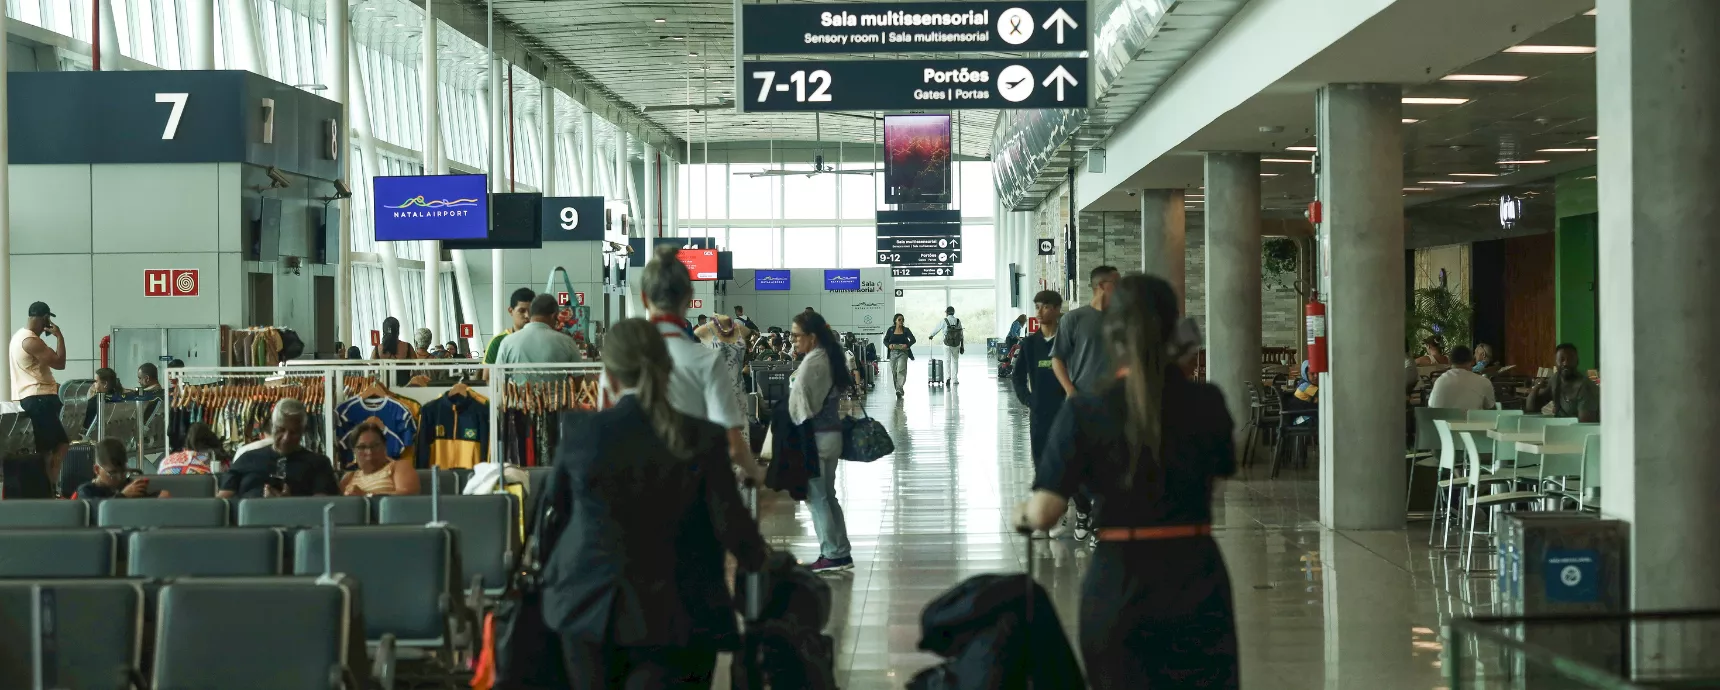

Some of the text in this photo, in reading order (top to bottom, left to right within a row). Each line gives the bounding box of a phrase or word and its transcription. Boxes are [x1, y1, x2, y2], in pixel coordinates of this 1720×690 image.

[820, 9, 989, 27] Sala multissensorial
[804, 32, 848, 45] Sensory
[850, 34, 879, 44] room
[889, 32, 911, 43] Sala
[914, 31, 989, 43] multisensorial
[924, 68, 989, 83] Portões
[753, 70, 832, 103] 7-12
[914, 89, 945, 101] Gates
[955, 88, 989, 100] Portas
[155, 92, 189, 140] 7
[326, 118, 338, 161] 8
[393, 210, 468, 218] NATAL AIRPORT
[560, 207, 579, 230] 9
[880, 253, 901, 262] 9-12
[892, 268, 910, 276] 11-12
[150, 273, 166, 293] H
